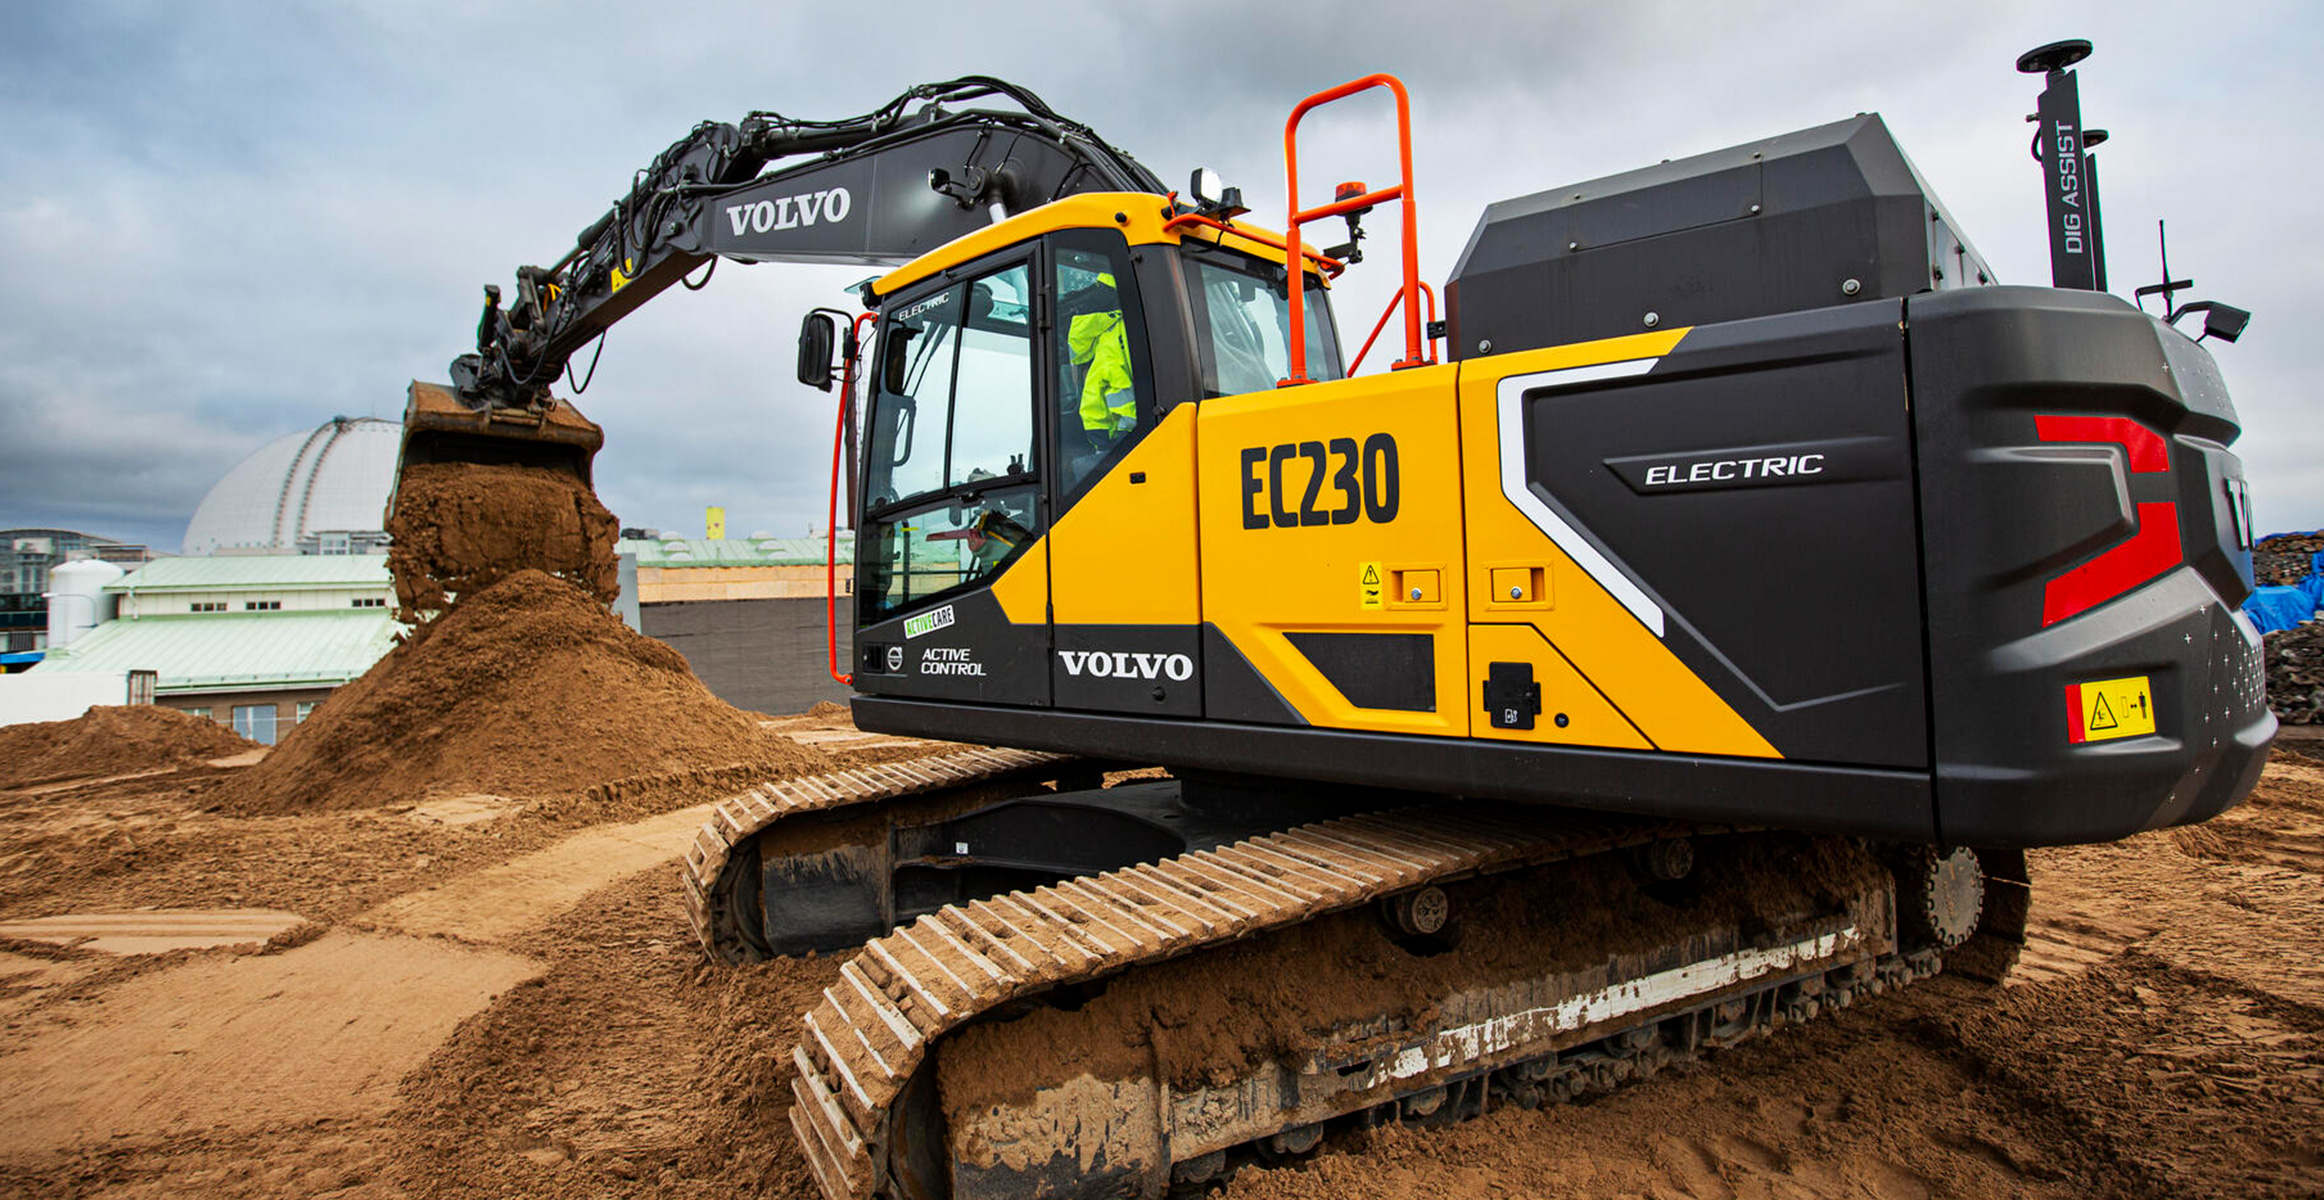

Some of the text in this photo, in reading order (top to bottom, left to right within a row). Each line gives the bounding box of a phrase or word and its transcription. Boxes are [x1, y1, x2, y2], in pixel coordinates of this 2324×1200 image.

[2056, 120, 2084, 254] DIG ASSIST
[726, 186, 851, 236] VOLVO
[898, 292, 950, 322] ELECTRIC
[1240, 432, 1400, 530] EC230
[1645, 454, 1825, 486] ELECTRIC
[906, 607, 953, 637] ACTIVECARE
[921, 661, 988, 676] CONTROL
[922, 648, 971, 661] ACTIVE
[1058, 651, 1194, 682] VOLVO
